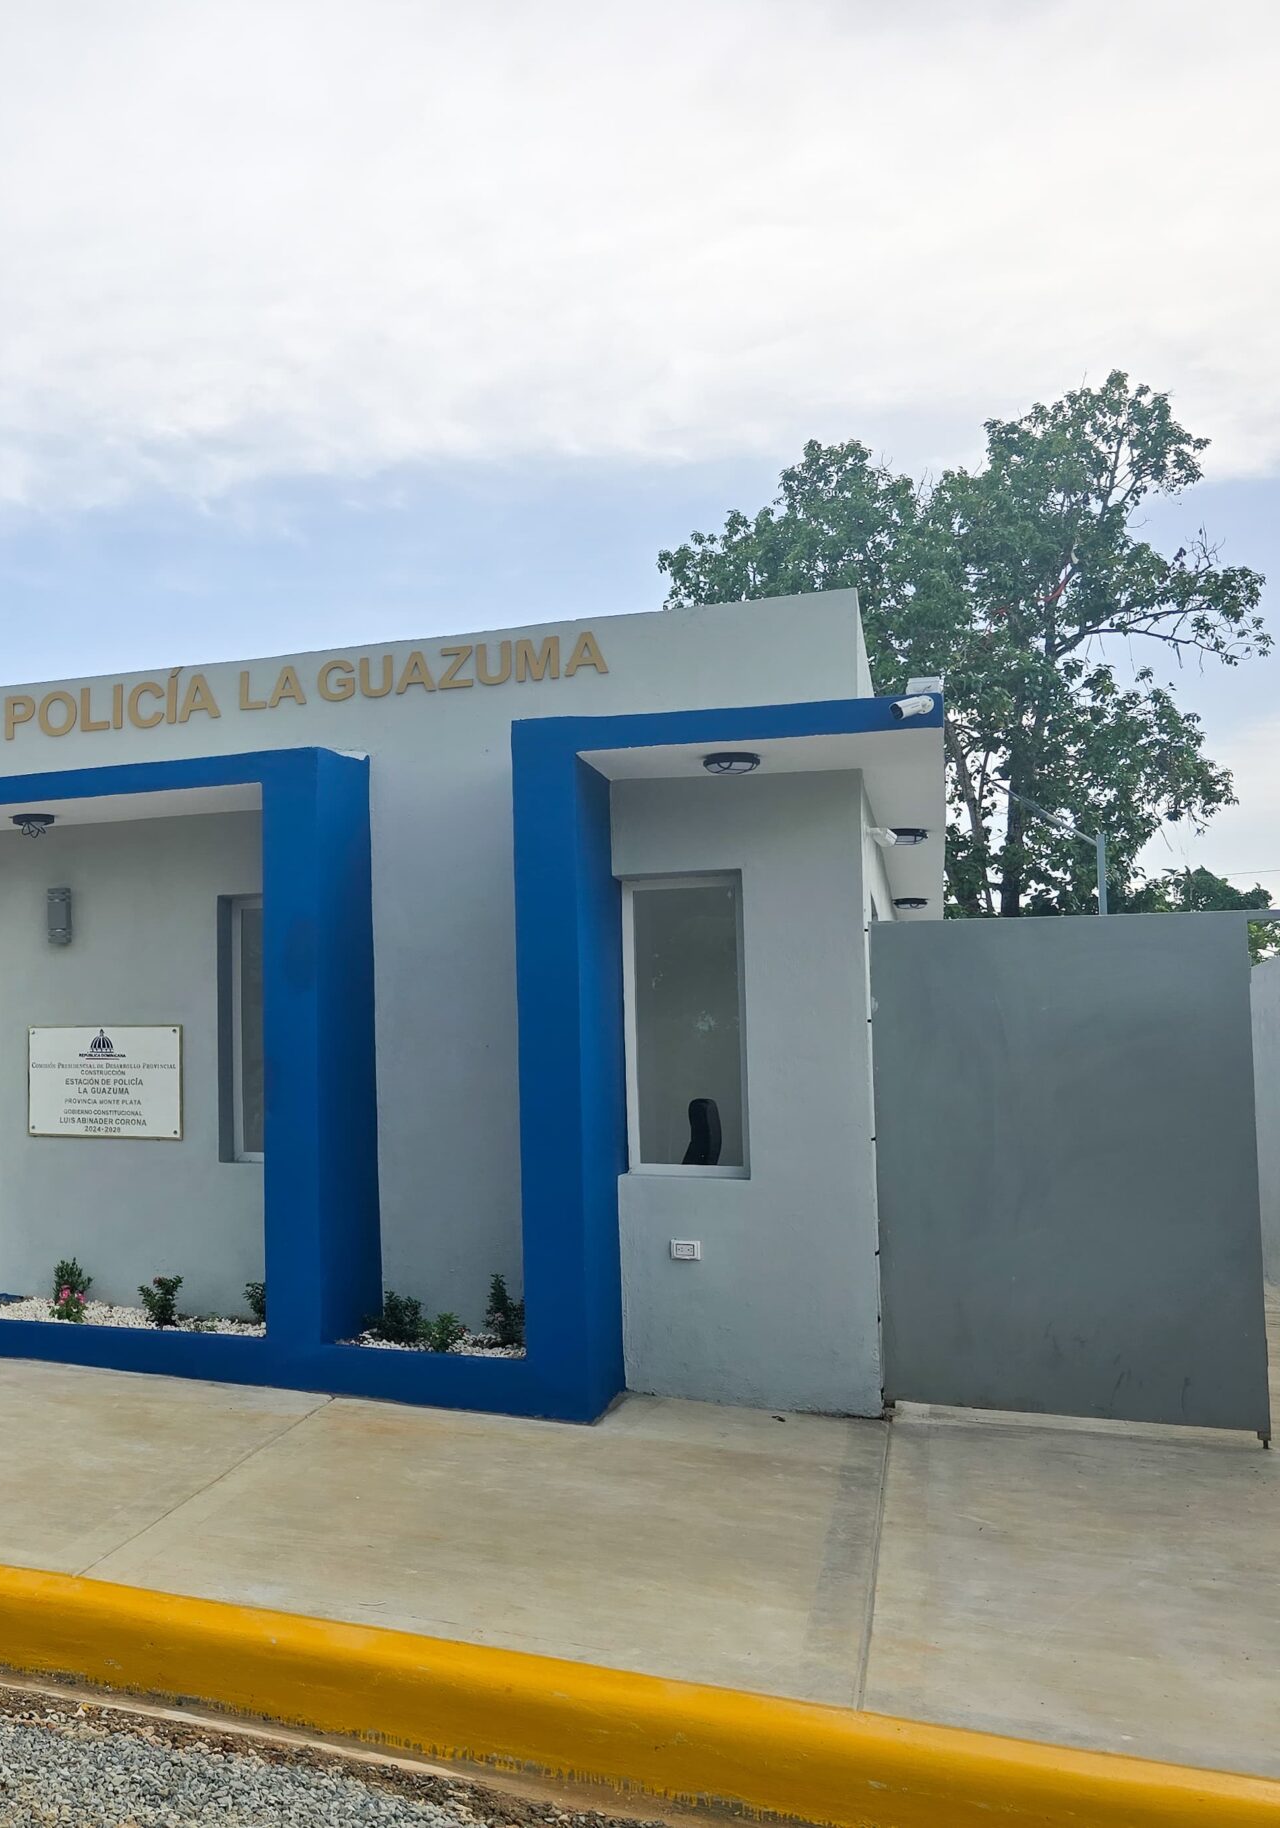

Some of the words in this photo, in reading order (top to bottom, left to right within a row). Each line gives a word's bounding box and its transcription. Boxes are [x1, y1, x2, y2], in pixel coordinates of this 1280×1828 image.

[4, 667, 221, 740] POLICÍA
[239, 665, 307, 711] LA
[317, 631, 609, 702] GUAZUMA
[65, 1077, 100, 1086] ESTACIÓN
[113, 1077, 144, 1086] POLICÍA
[90, 1087, 130, 1095] GUAZUMA
[76, 1117, 114, 1125] ABINADER
[115, 1118, 147, 1126] CORONA
